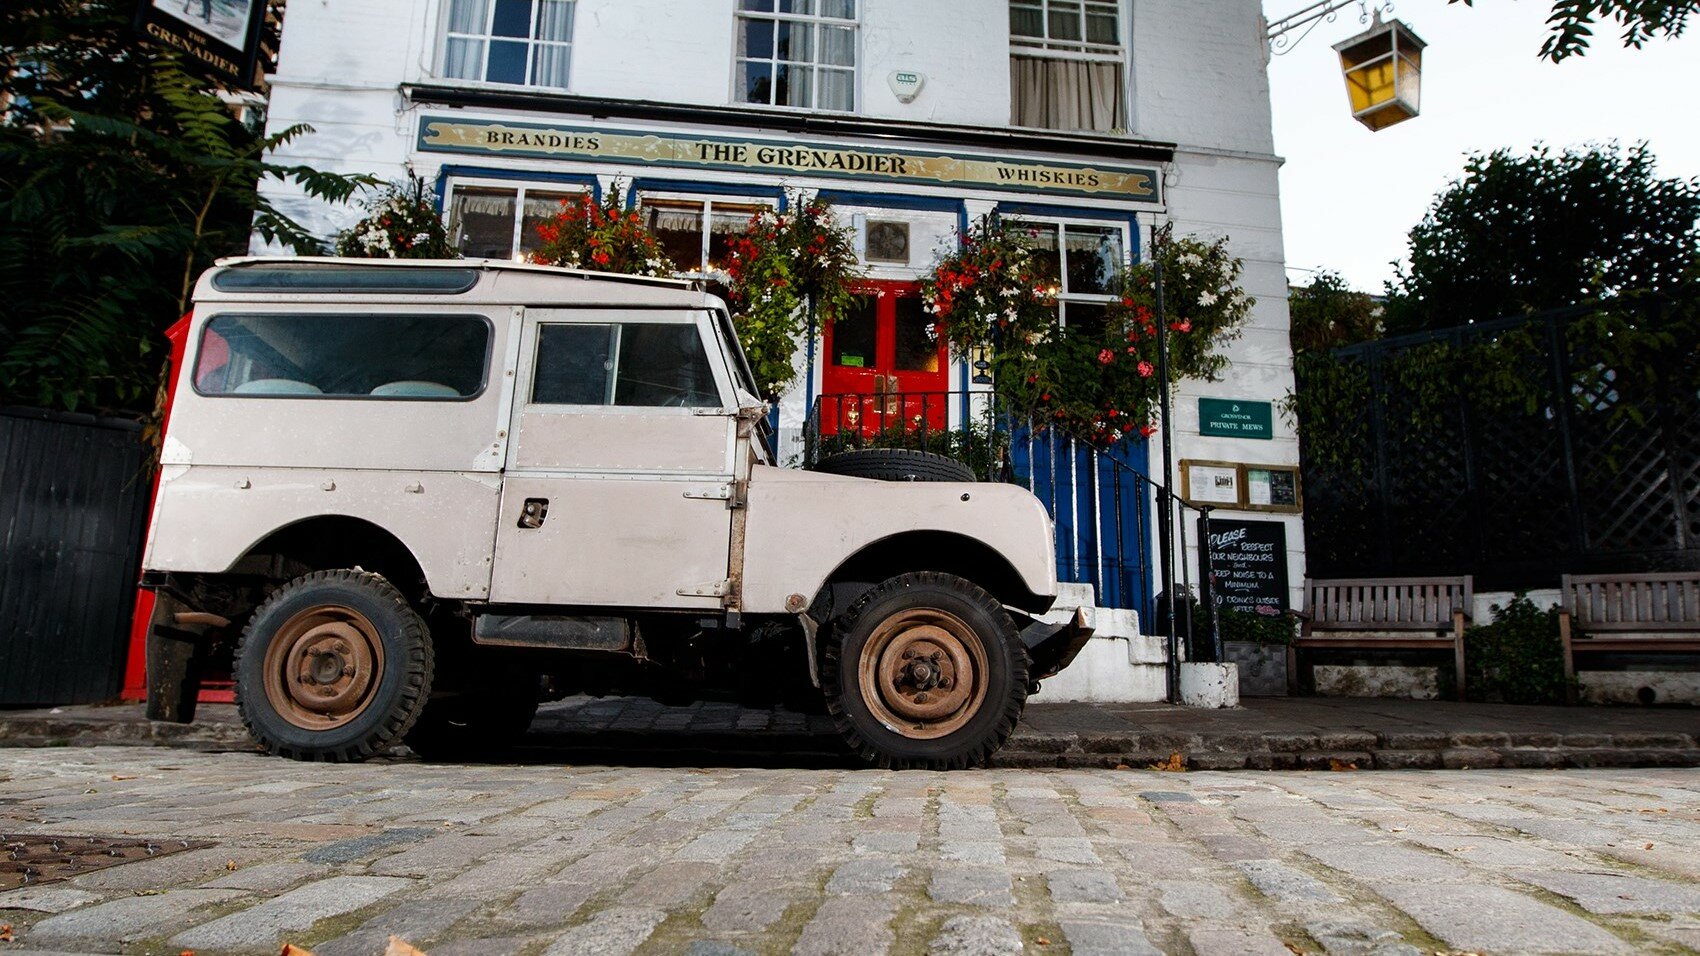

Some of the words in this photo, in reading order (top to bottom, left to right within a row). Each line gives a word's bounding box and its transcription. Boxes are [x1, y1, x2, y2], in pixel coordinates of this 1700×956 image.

[188, 30, 207, 44] THE
[147, 23, 239, 76] GRENADIER
[487, 131, 599, 150] BRANDIES
[696, 143, 748, 162] THE
[757, 148, 907, 174] GRENADIER
[997, 168, 1099, 186] WHISKIES
[1210, 421, 1238, 429] PRIVATE
[1242, 423, 1263, 431] MEWS
[1210, 528, 1247, 546] PLEASE
[1227, 553, 1274, 562] NEIGHBOURS
[1225, 580, 1259, 588] MINIMUM
